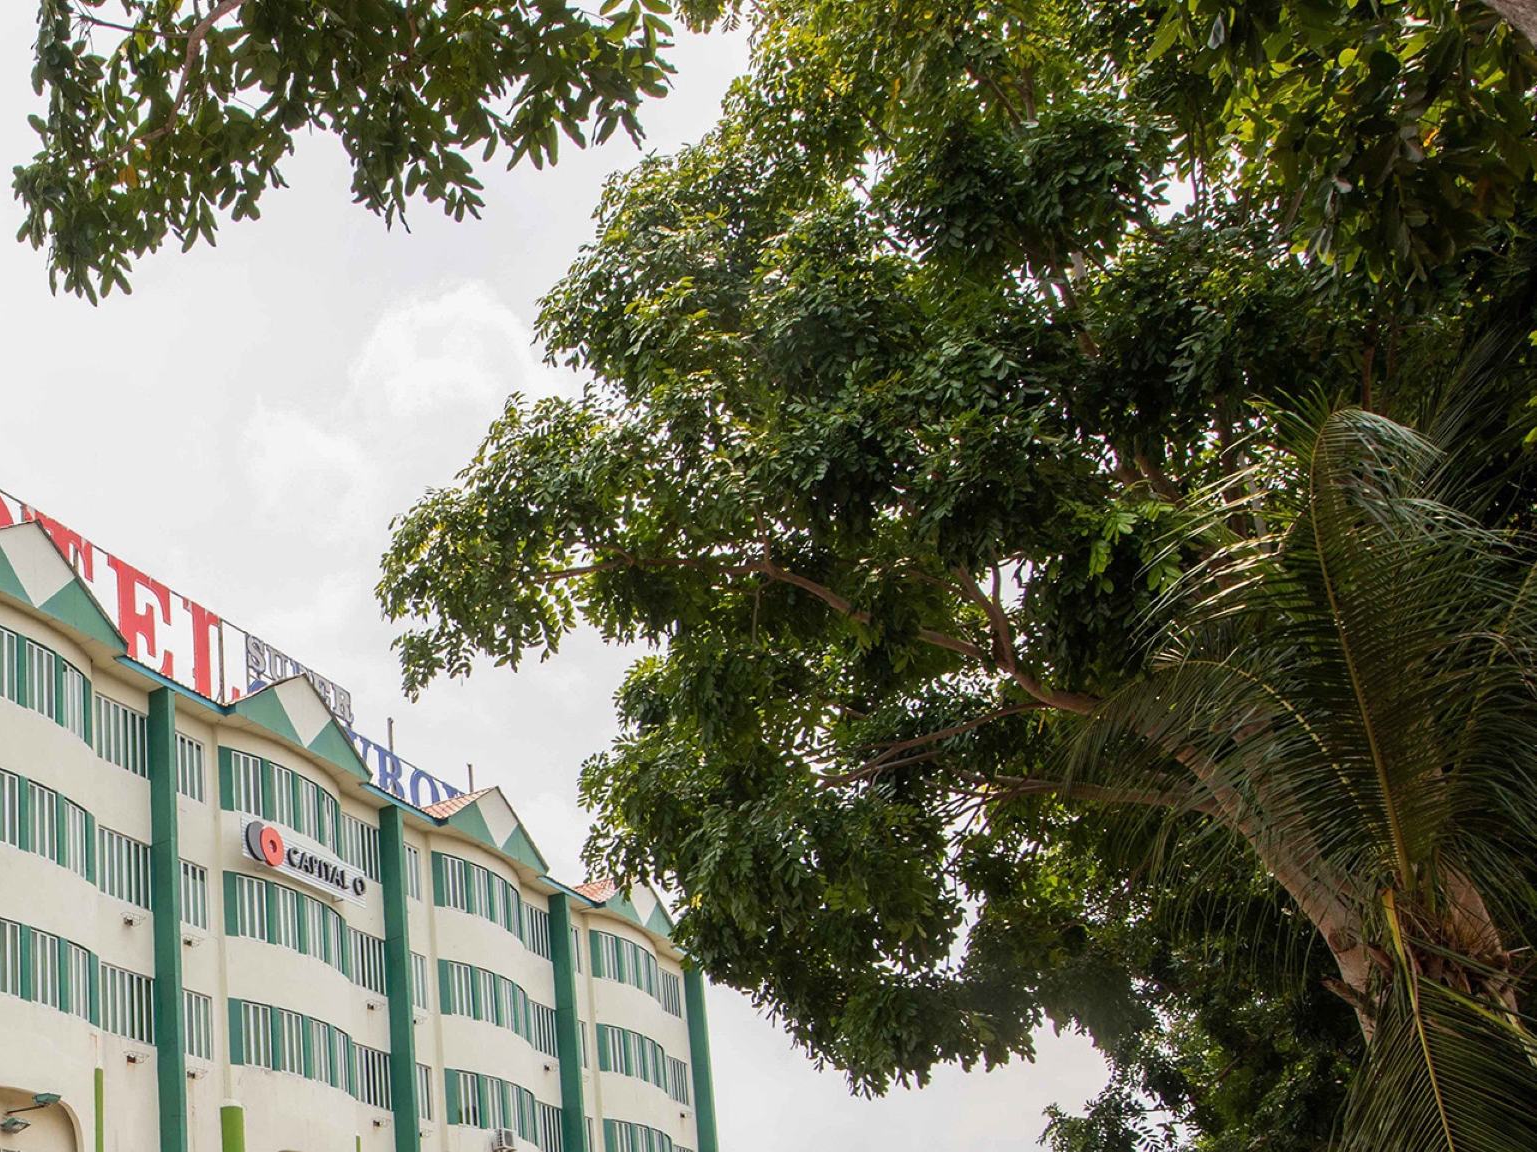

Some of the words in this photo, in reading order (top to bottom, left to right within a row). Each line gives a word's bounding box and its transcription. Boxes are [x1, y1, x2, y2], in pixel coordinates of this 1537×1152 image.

[246, 634, 354, 724] SUER
[287, 846, 349, 889] CAPITAL
[353, 877, 367, 896] O
